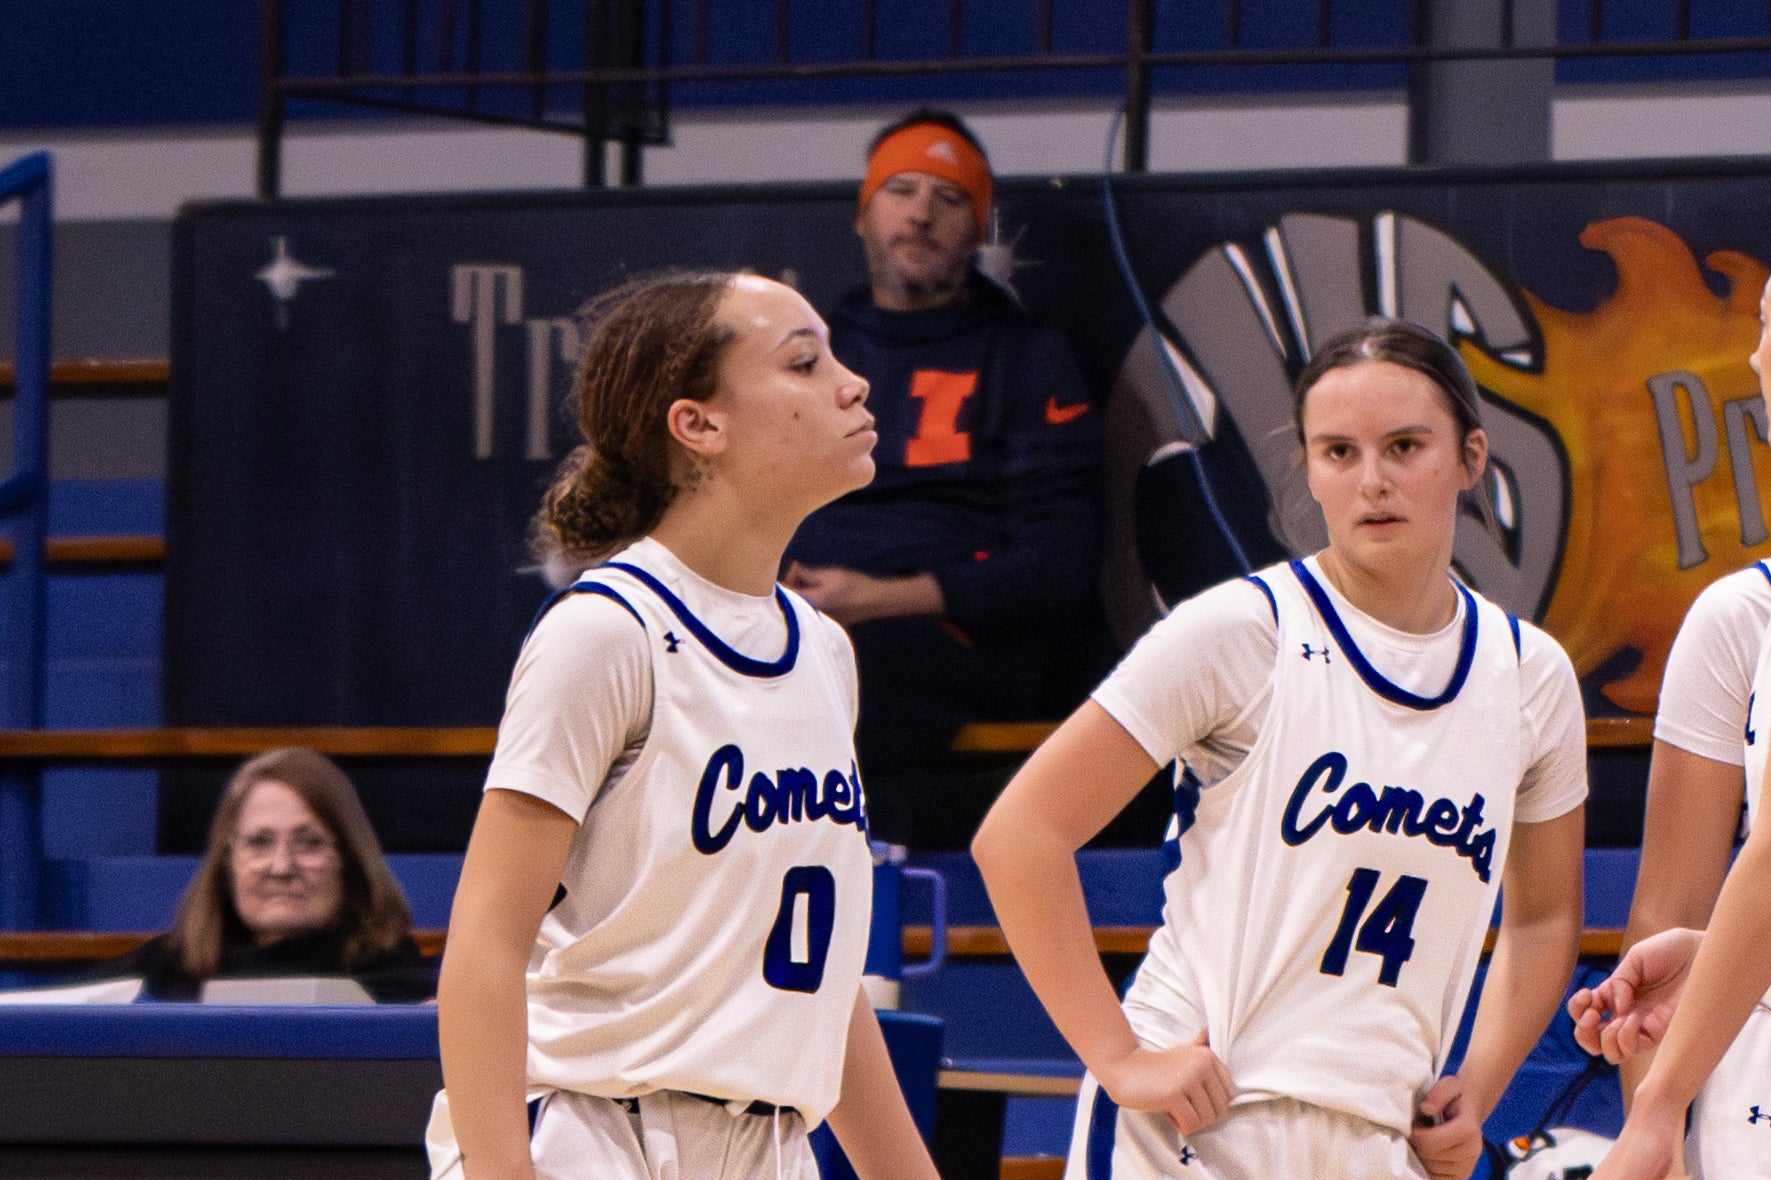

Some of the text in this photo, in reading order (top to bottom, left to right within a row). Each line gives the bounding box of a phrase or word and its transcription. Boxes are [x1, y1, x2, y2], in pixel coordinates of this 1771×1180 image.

[1281, 751, 1496, 884] Comets
[762, 865, 836, 994] 0
[1319, 867, 1428, 988] 14
